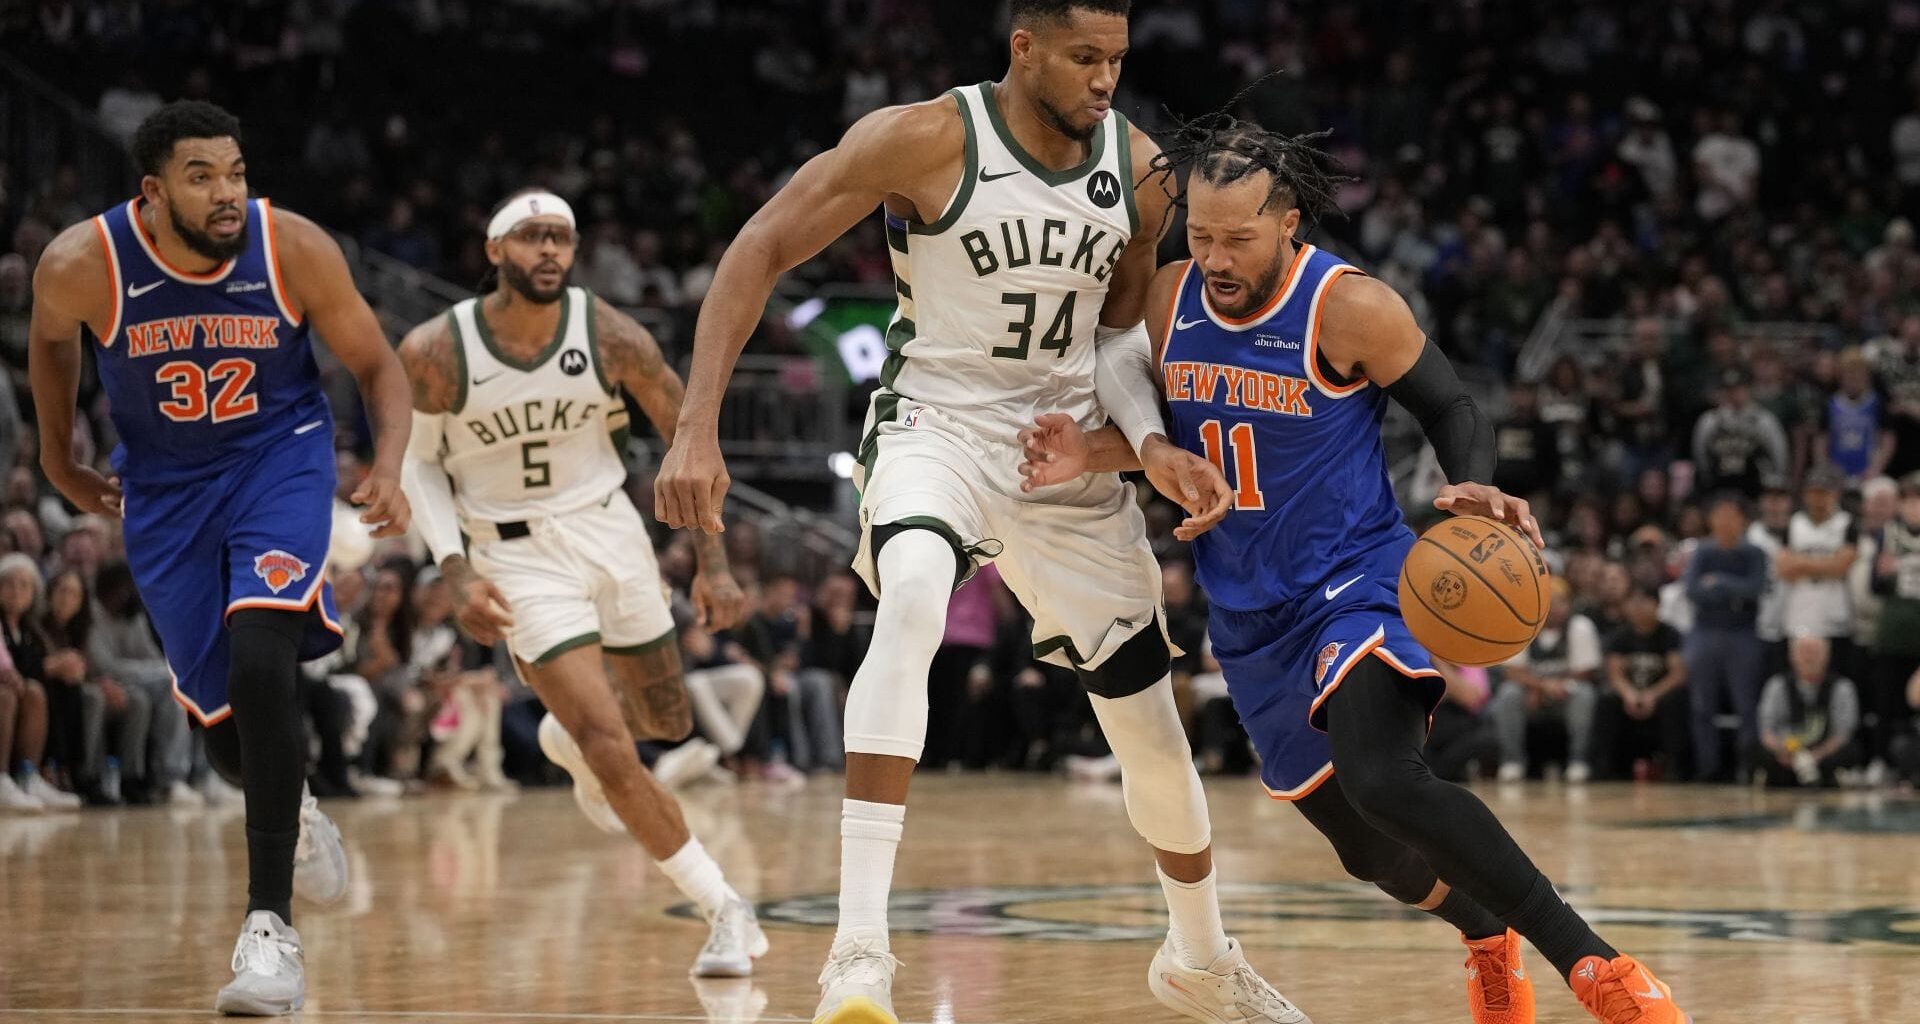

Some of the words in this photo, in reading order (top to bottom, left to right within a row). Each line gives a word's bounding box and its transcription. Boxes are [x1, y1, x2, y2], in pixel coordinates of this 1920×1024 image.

[959, 218, 1125, 283] BUCKS
[126, 316, 197, 358] NEW
[198, 314, 280, 349] YORK
[991, 290, 1078, 361] 34
[1254, 338, 1272, 347] abu
[1273, 339, 1301, 350] dhabi
[155, 357, 259, 424] 32
[1164, 361, 1220, 403] NEW
[1221, 366, 1313, 417] YORK
[521, 440, 551, 488] 5
